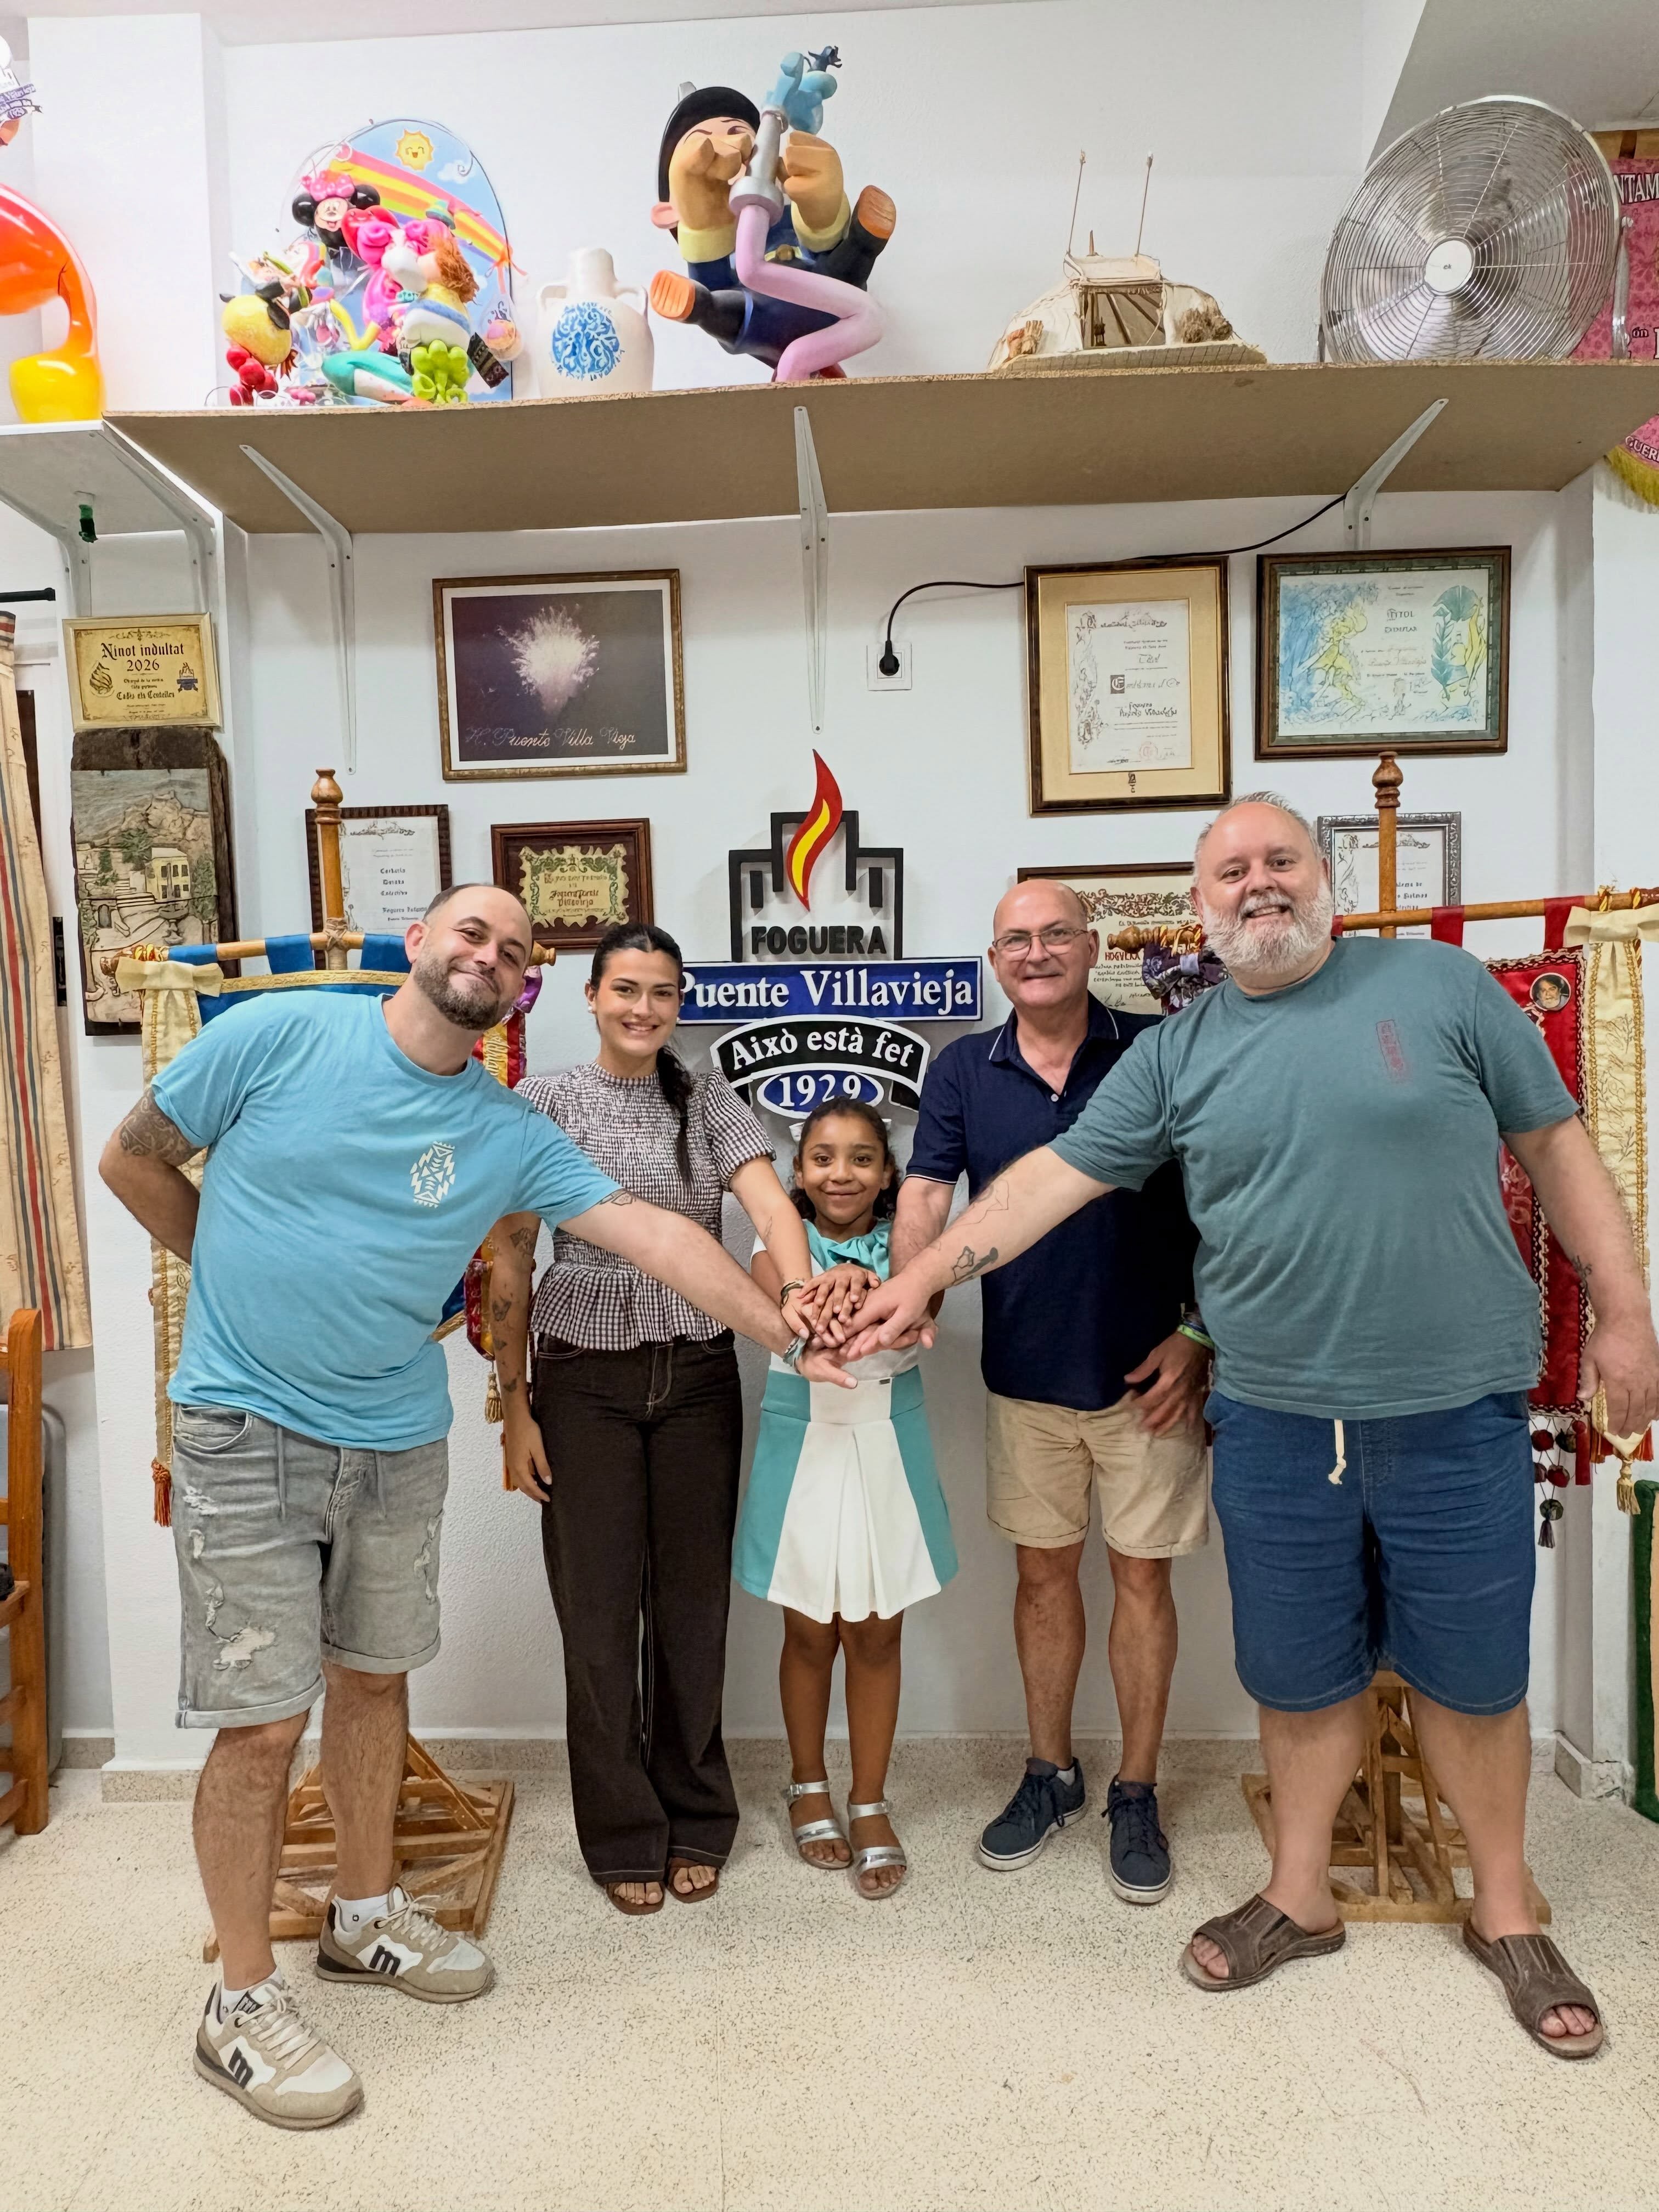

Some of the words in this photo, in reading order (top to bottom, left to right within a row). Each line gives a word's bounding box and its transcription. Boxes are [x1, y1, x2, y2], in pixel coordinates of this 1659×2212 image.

[1625, 436, 1659, 462] GUER
[101, 642, 135, 660] Ninot
[140, 642, 184, 656] indultat
[127, 659, 160, 672] 2026
[554, 727, 594, 747] Villa
[751, 926, 887, 955] FOGUERA
[680, 972, 789, 1007] Puente
[800, 968, 973, 1015] Villavieja
[731, 1028, 797, 1070] Això
[806, 1026, 863, 1054] està
[871, 1031, 914, 1067] fet
[778, 1074, 861, 1107] 1929
